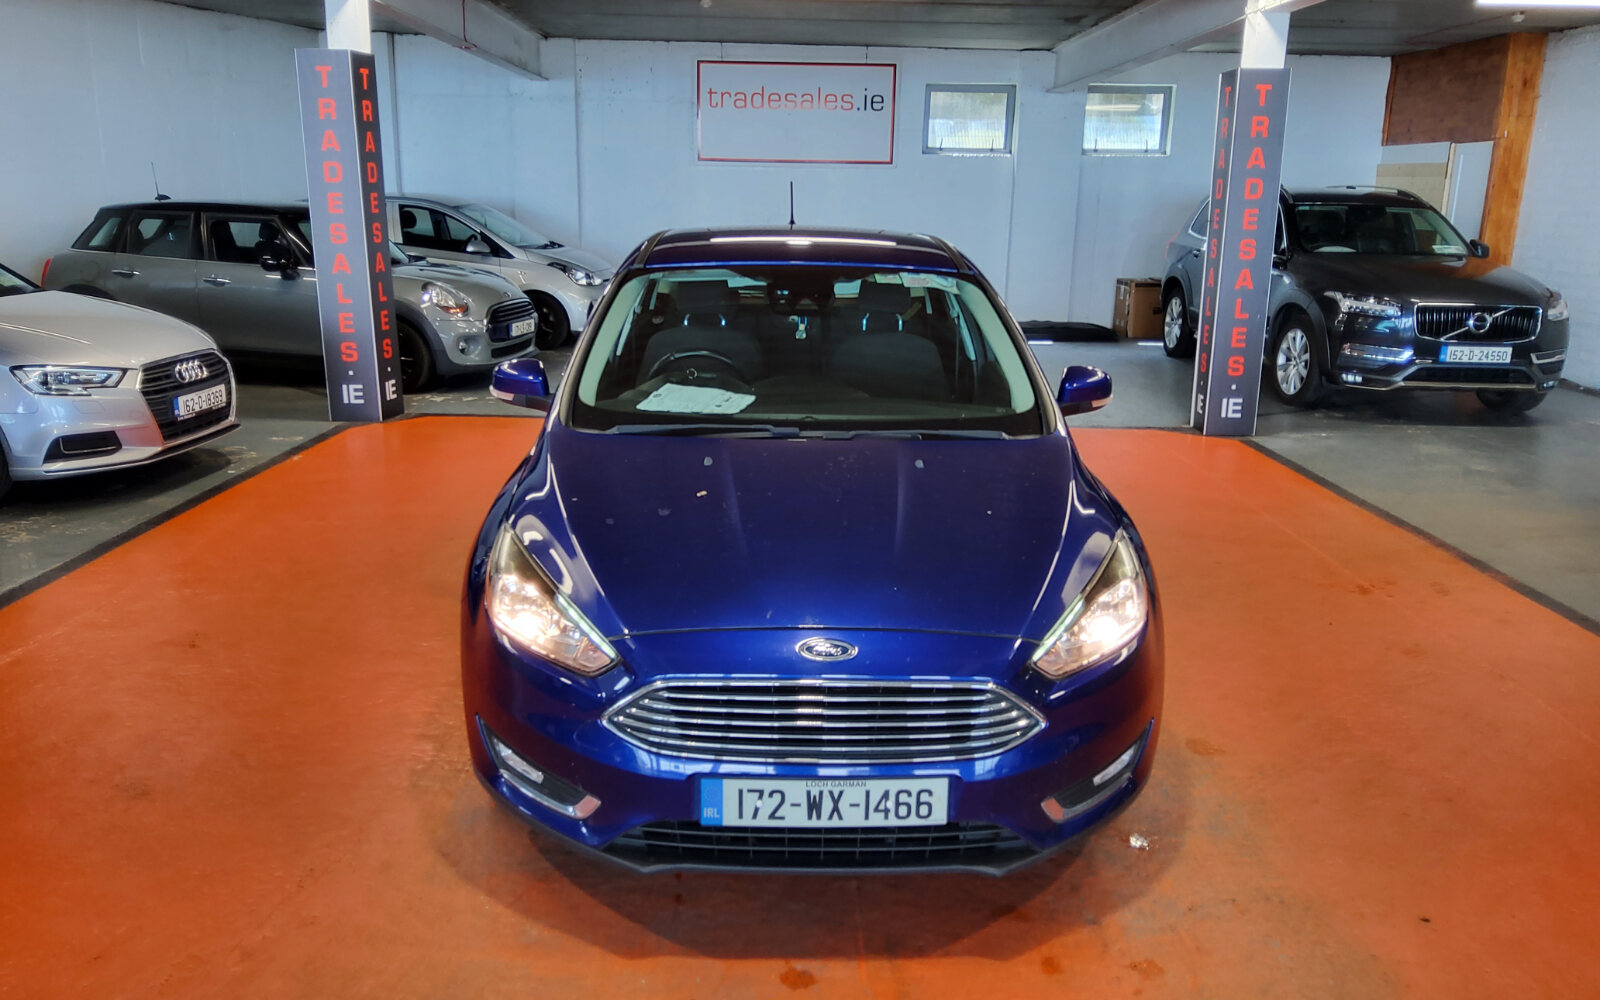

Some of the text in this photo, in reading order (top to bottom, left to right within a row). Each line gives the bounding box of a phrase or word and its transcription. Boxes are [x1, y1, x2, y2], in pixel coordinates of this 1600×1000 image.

[707, 85, 885, 112] tradesales.ie
[1448, 350, 1508, 361] 152-D-24550
[805, 780, 867, 788] LOCH GARMAN
[738, 788, 933, 821] 172-WX-1466
[703, 807, 720, 818] IRL
